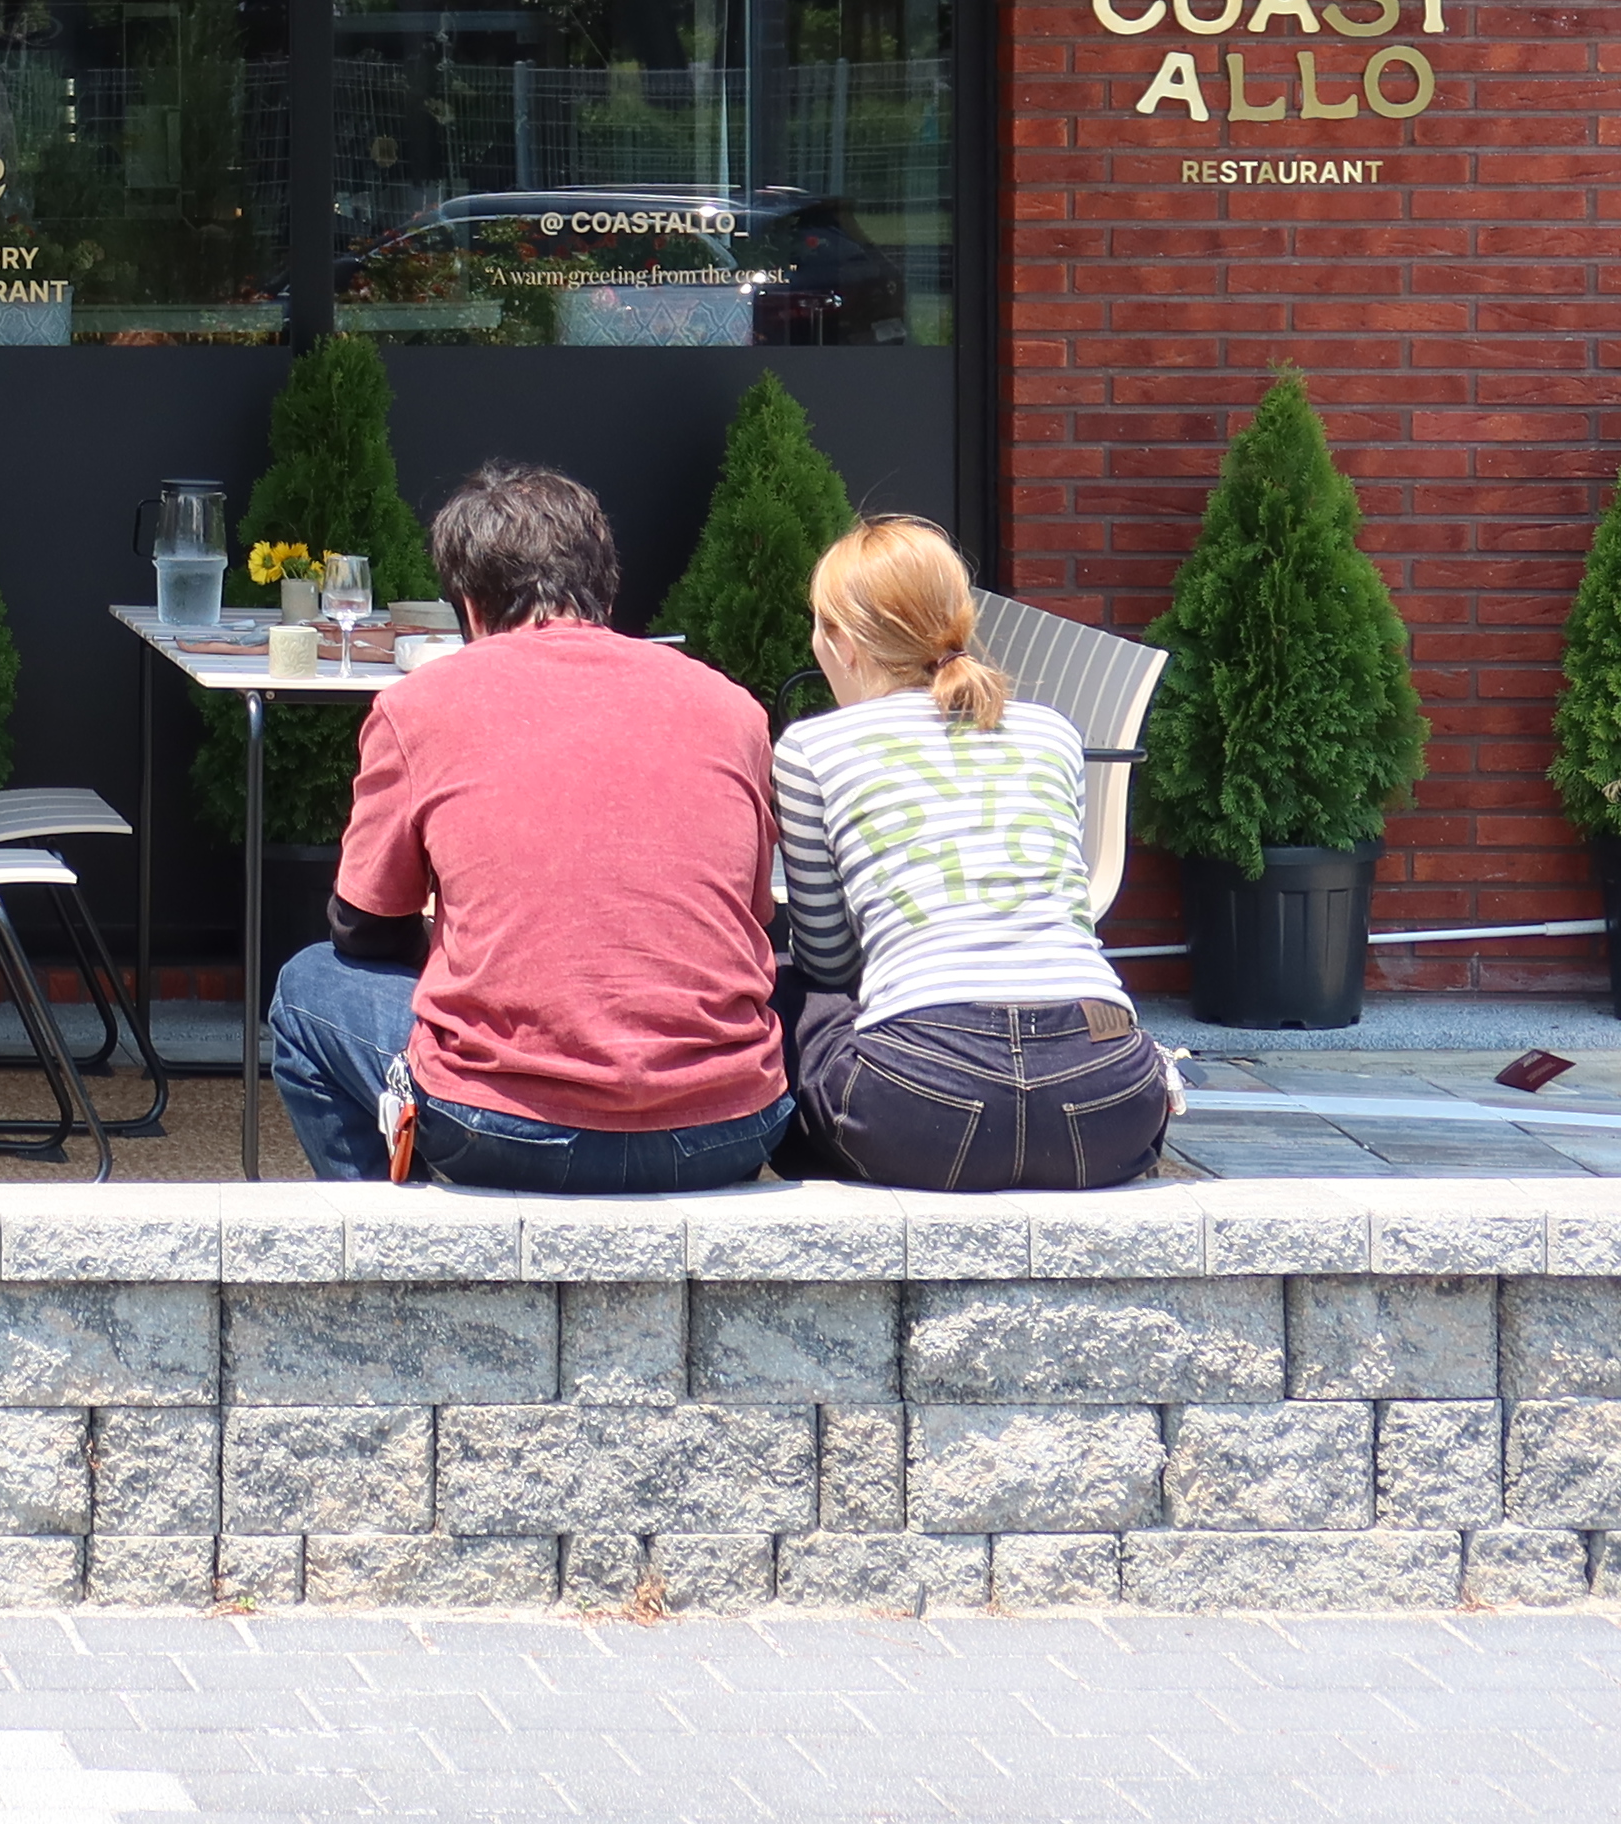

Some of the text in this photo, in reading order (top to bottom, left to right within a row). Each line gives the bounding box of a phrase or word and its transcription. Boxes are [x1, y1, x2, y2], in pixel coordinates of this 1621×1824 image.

[1135, 44, 1436, 122] ALLO
[1181, 160, 1385, 184] RESTAURANT
[509, 270, 566, 285] warm
[568, 264, 647, 289] greeting
[651, 263, 697, 285] from
[699, 263, 731, 284] the
